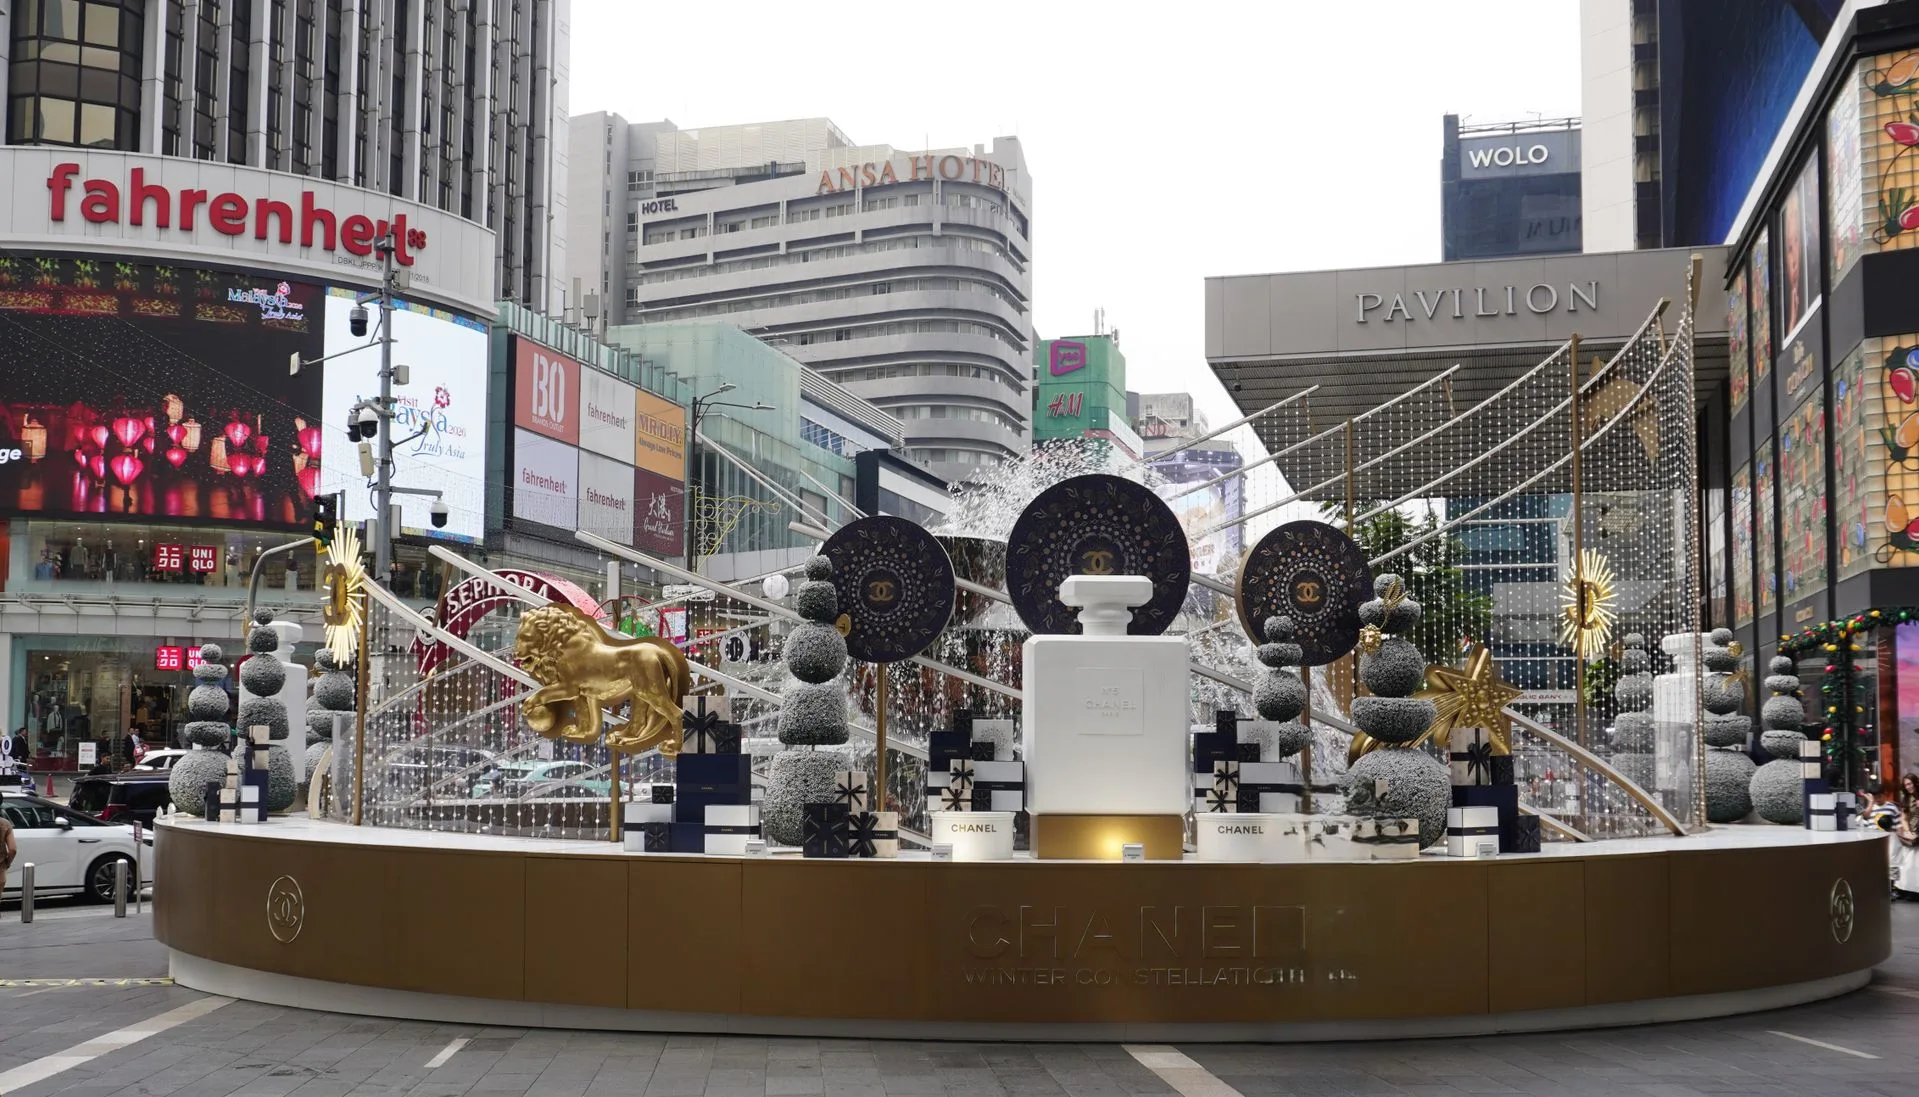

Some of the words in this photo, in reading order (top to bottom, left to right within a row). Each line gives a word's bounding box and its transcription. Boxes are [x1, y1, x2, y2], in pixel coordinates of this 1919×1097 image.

[1468, 144, 1549, 168] WOLO
[816, 160, 900, 195] ANSA
[908, 154, 1010, 192] HOTEL
[47, 163, 414, 267] fahrenheit
[641, 199, 679, 215] HOTEL
[1355, 281, 1600, 323] PAVILION
[532, 352, 565, 423] BO
[587, 402, 627, 430] fahrenheit
[1046, 391, 1084, 418] H&M
[445, 443, 466, 459] Asia
[522, 467, 567, 495] fahrenheit
[586, 487, 625, 511] fahrenheit
[446, 573, 550, 615] SEPHORA
[951, 823, 997, 833] CHANEL
[1217, 824, 1264, 835] CHANEL
[963, 967, 1066, 985] WINTER
